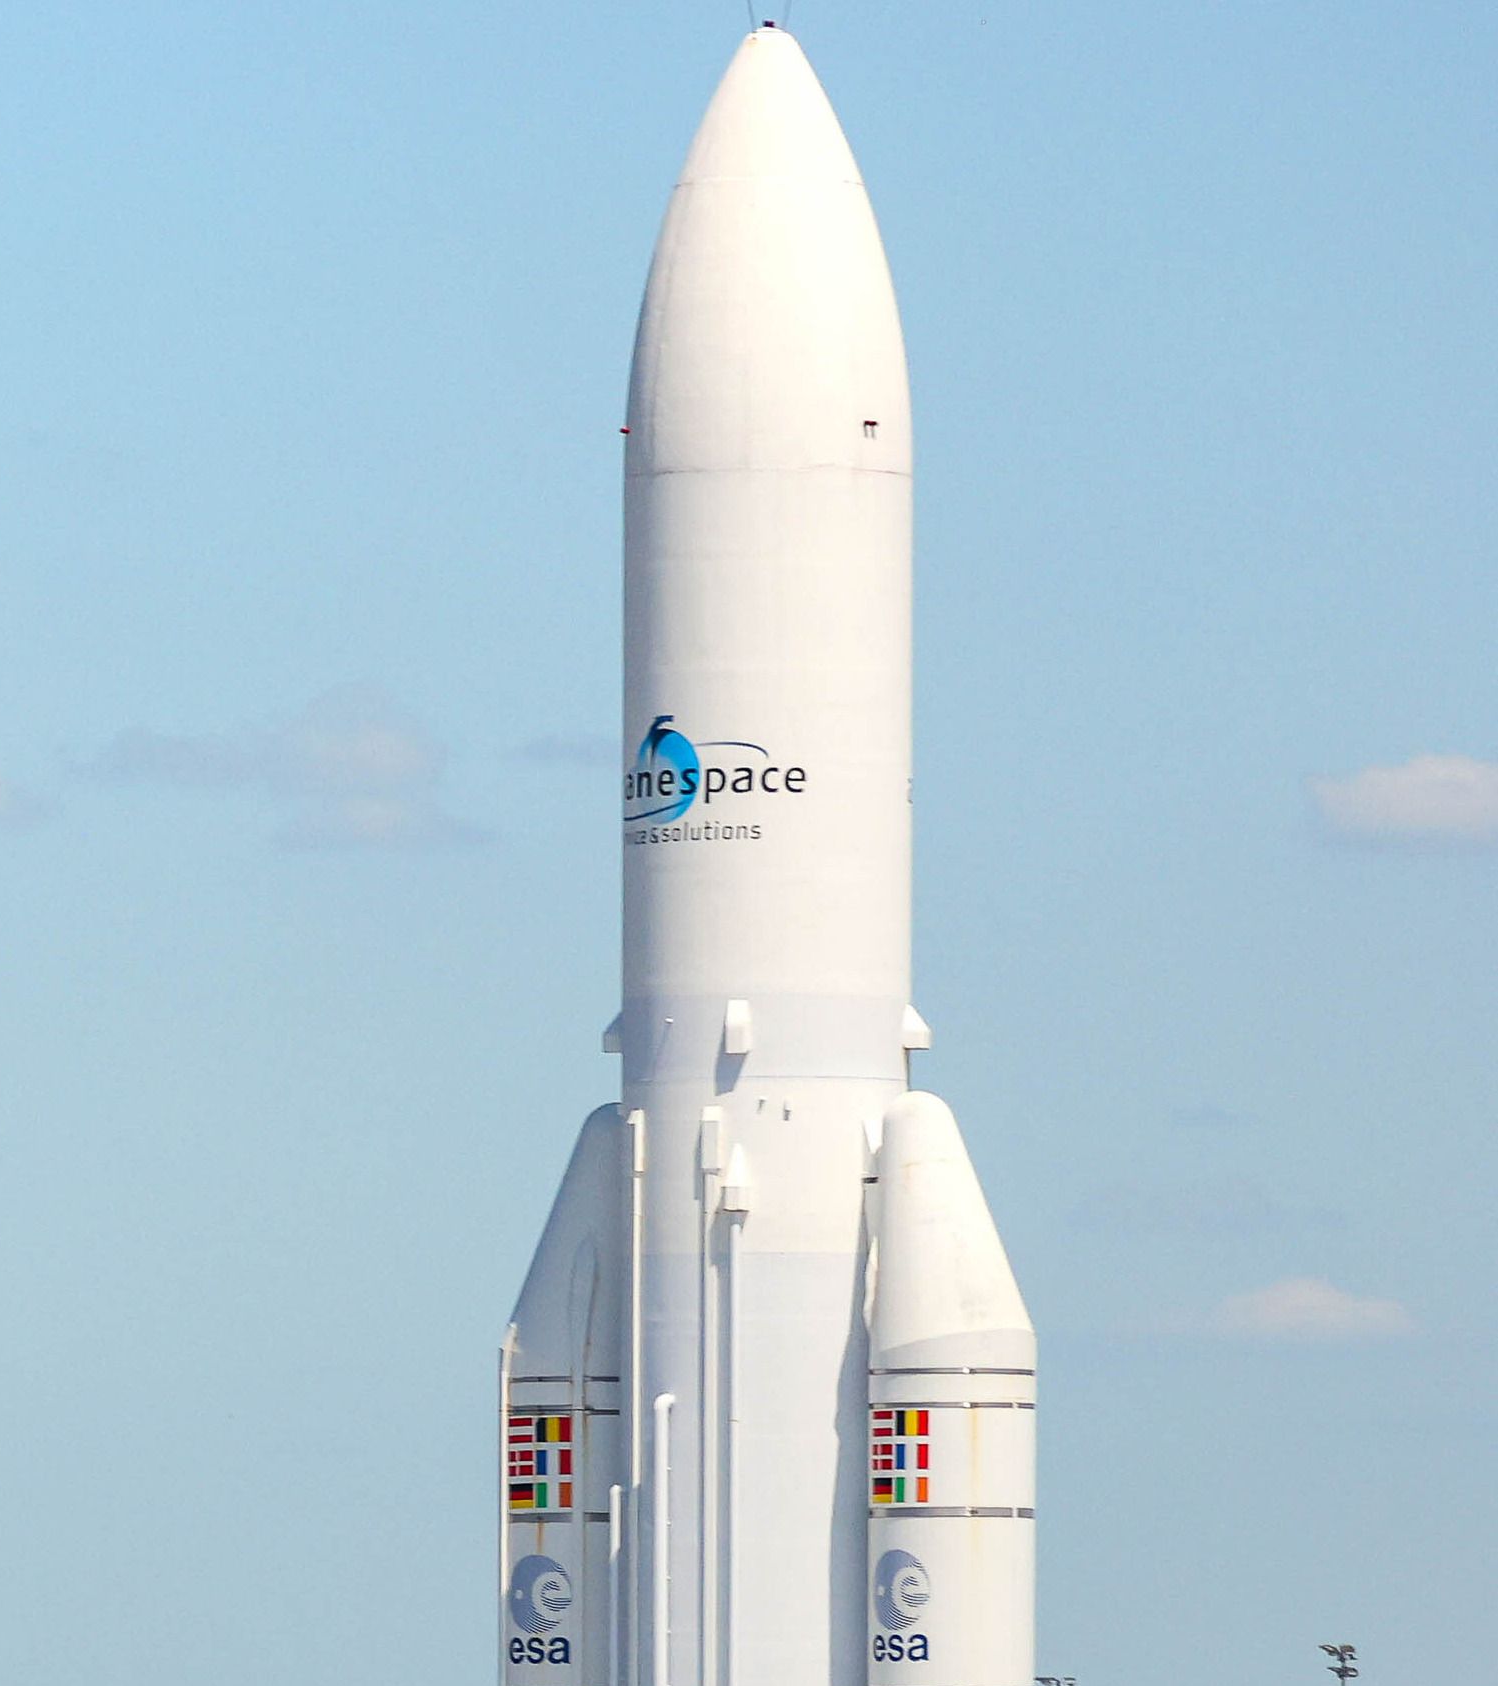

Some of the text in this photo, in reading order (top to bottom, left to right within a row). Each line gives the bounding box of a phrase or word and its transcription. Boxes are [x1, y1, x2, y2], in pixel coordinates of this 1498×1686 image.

[626, 767, 808, 803] anespace
[509, 1637, 571, 1665] esa
[873, 1633, 930, 1662] esa
